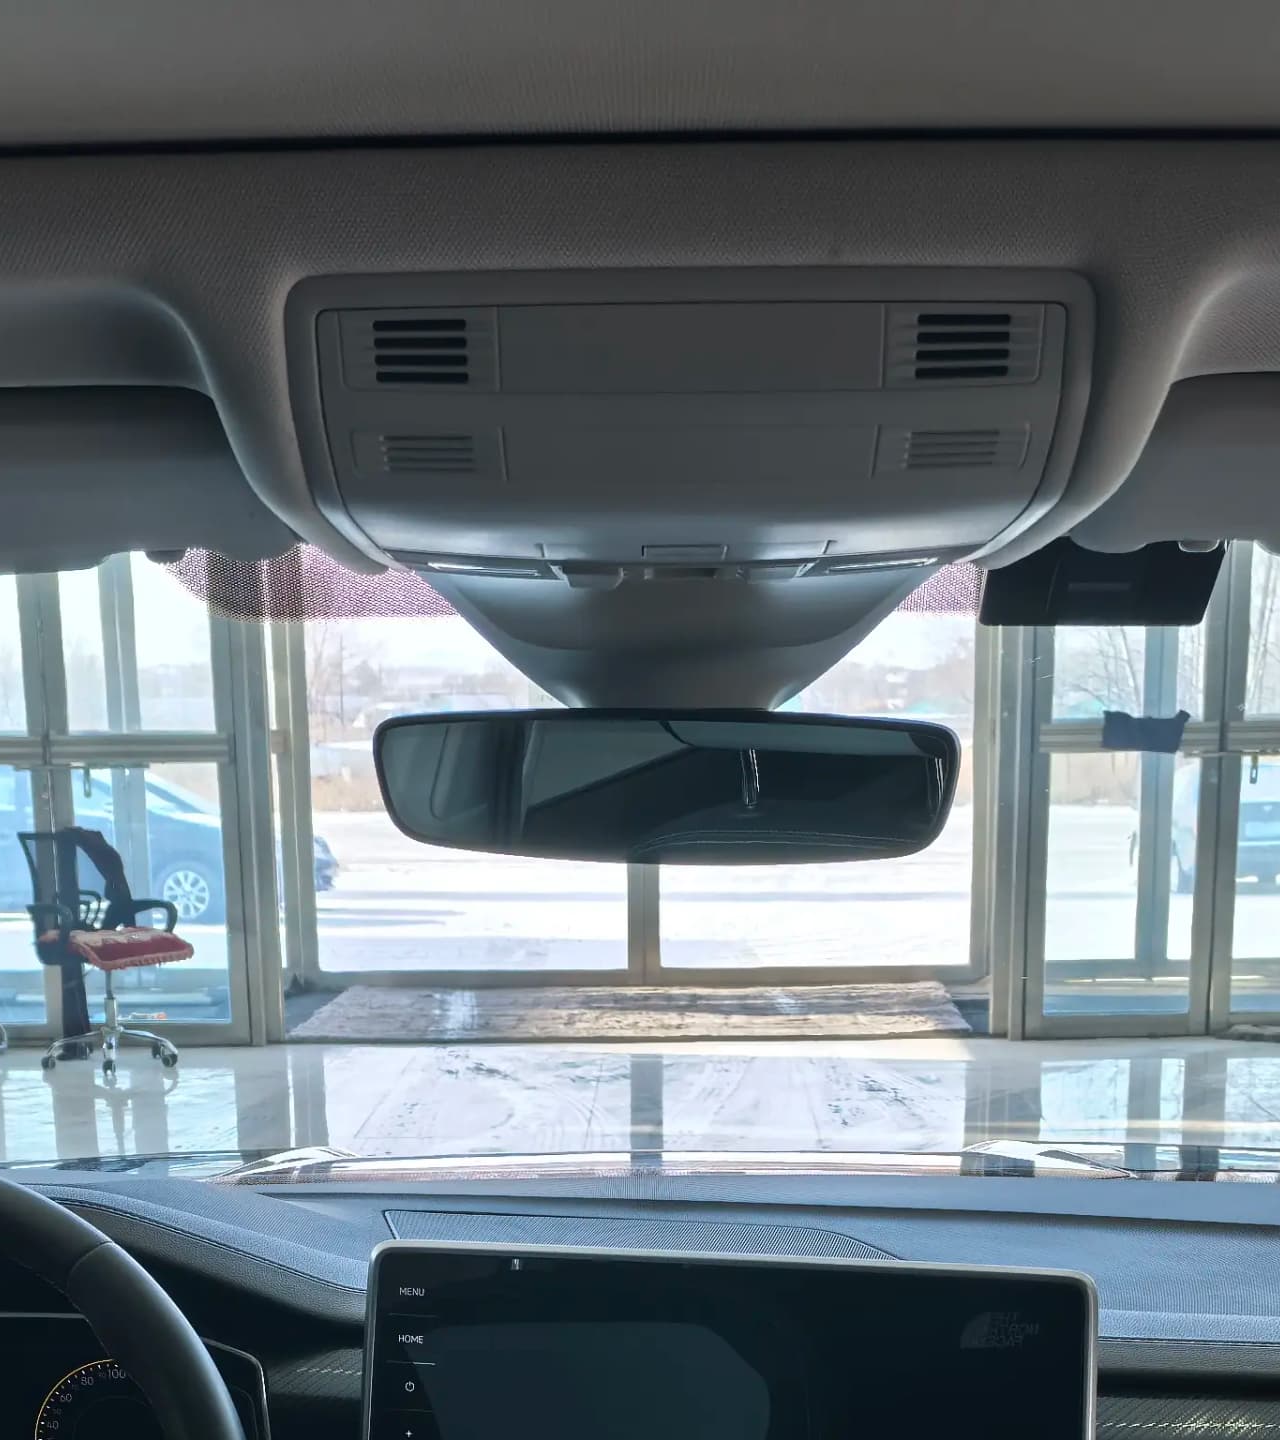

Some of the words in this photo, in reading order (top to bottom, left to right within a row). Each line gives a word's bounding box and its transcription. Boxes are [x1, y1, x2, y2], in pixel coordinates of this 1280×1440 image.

[399, 1286, 425, 1297] MENU
[398, 1334, 424, 1345] HOME
[107, 1368, 126, 1379] 100
[80, 1376, 94, 1386] 80
